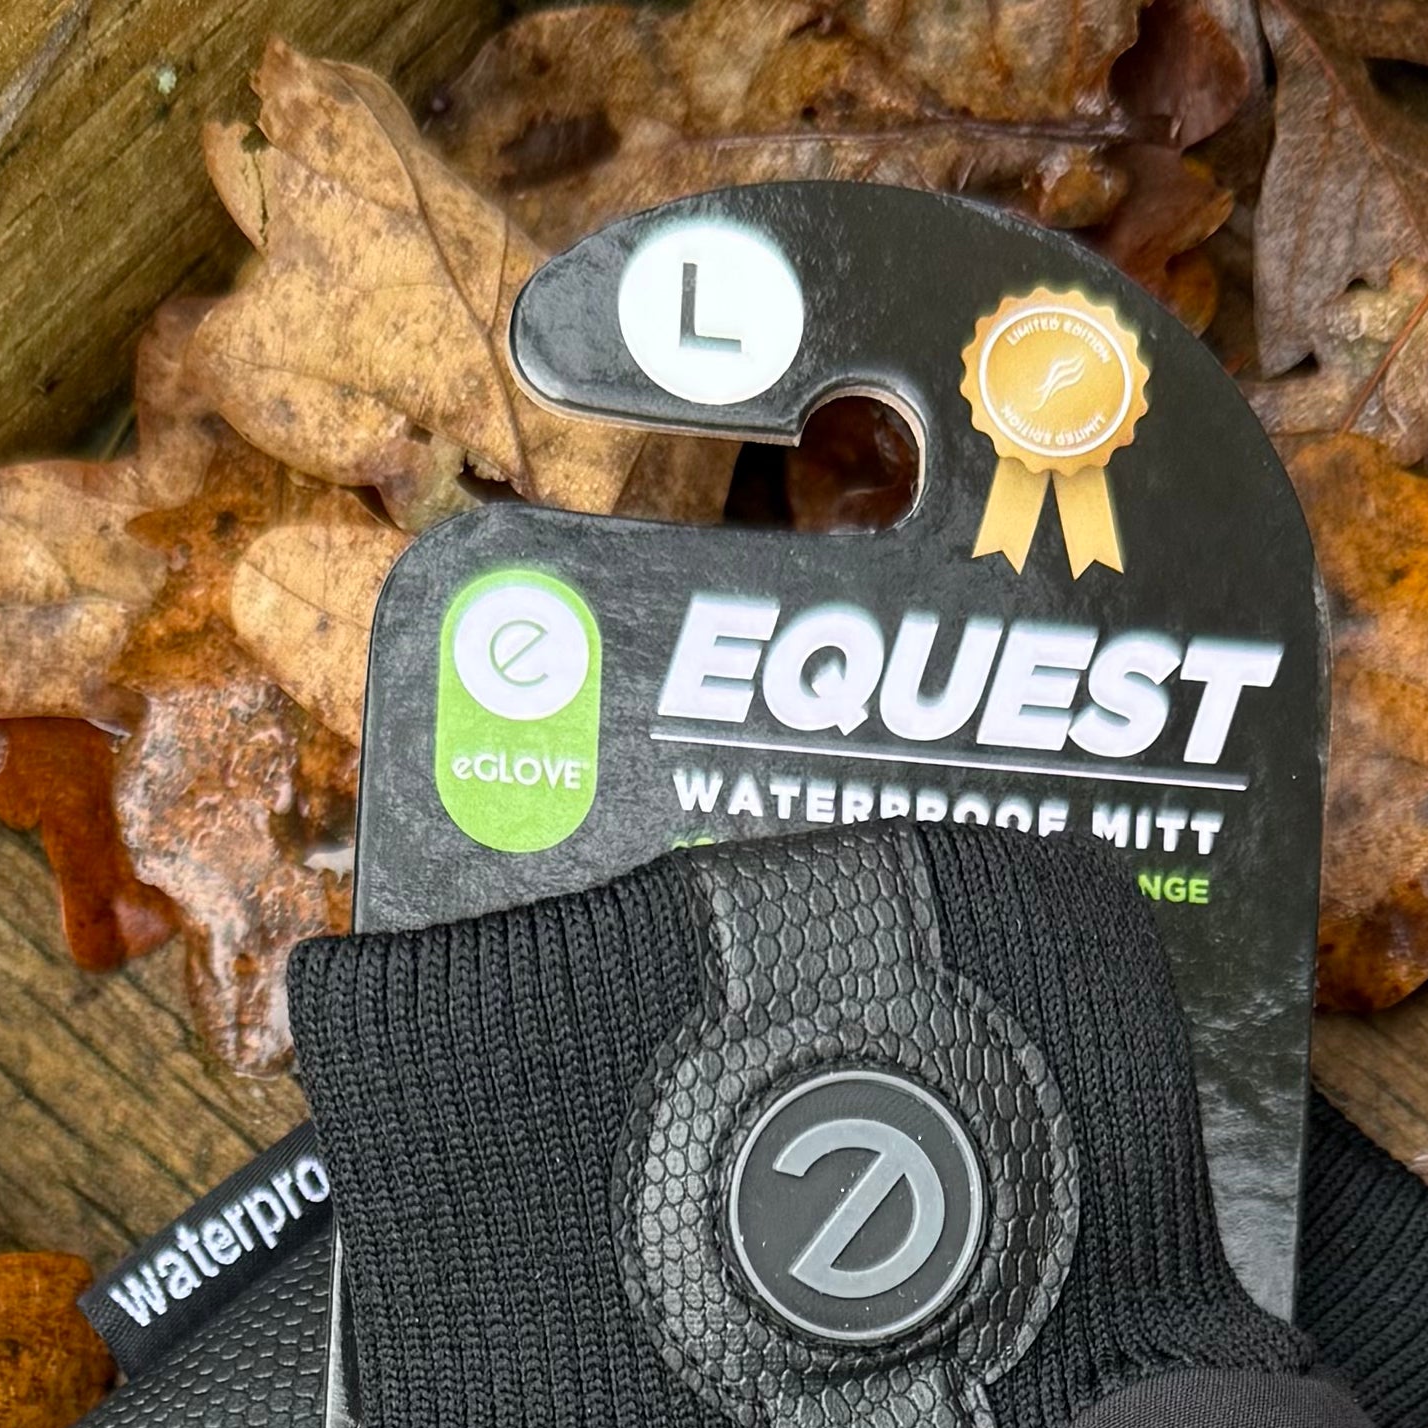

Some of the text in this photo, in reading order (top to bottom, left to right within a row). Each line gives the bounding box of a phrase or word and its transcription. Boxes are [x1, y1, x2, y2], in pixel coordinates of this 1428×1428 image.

[679, 262, 742, 352] L
[1006, 317, 1110, 363] LIMITED EDITION
[658, 594, 1284, 766] EQUEST
[1091, 803, 1225, 855] MITT
